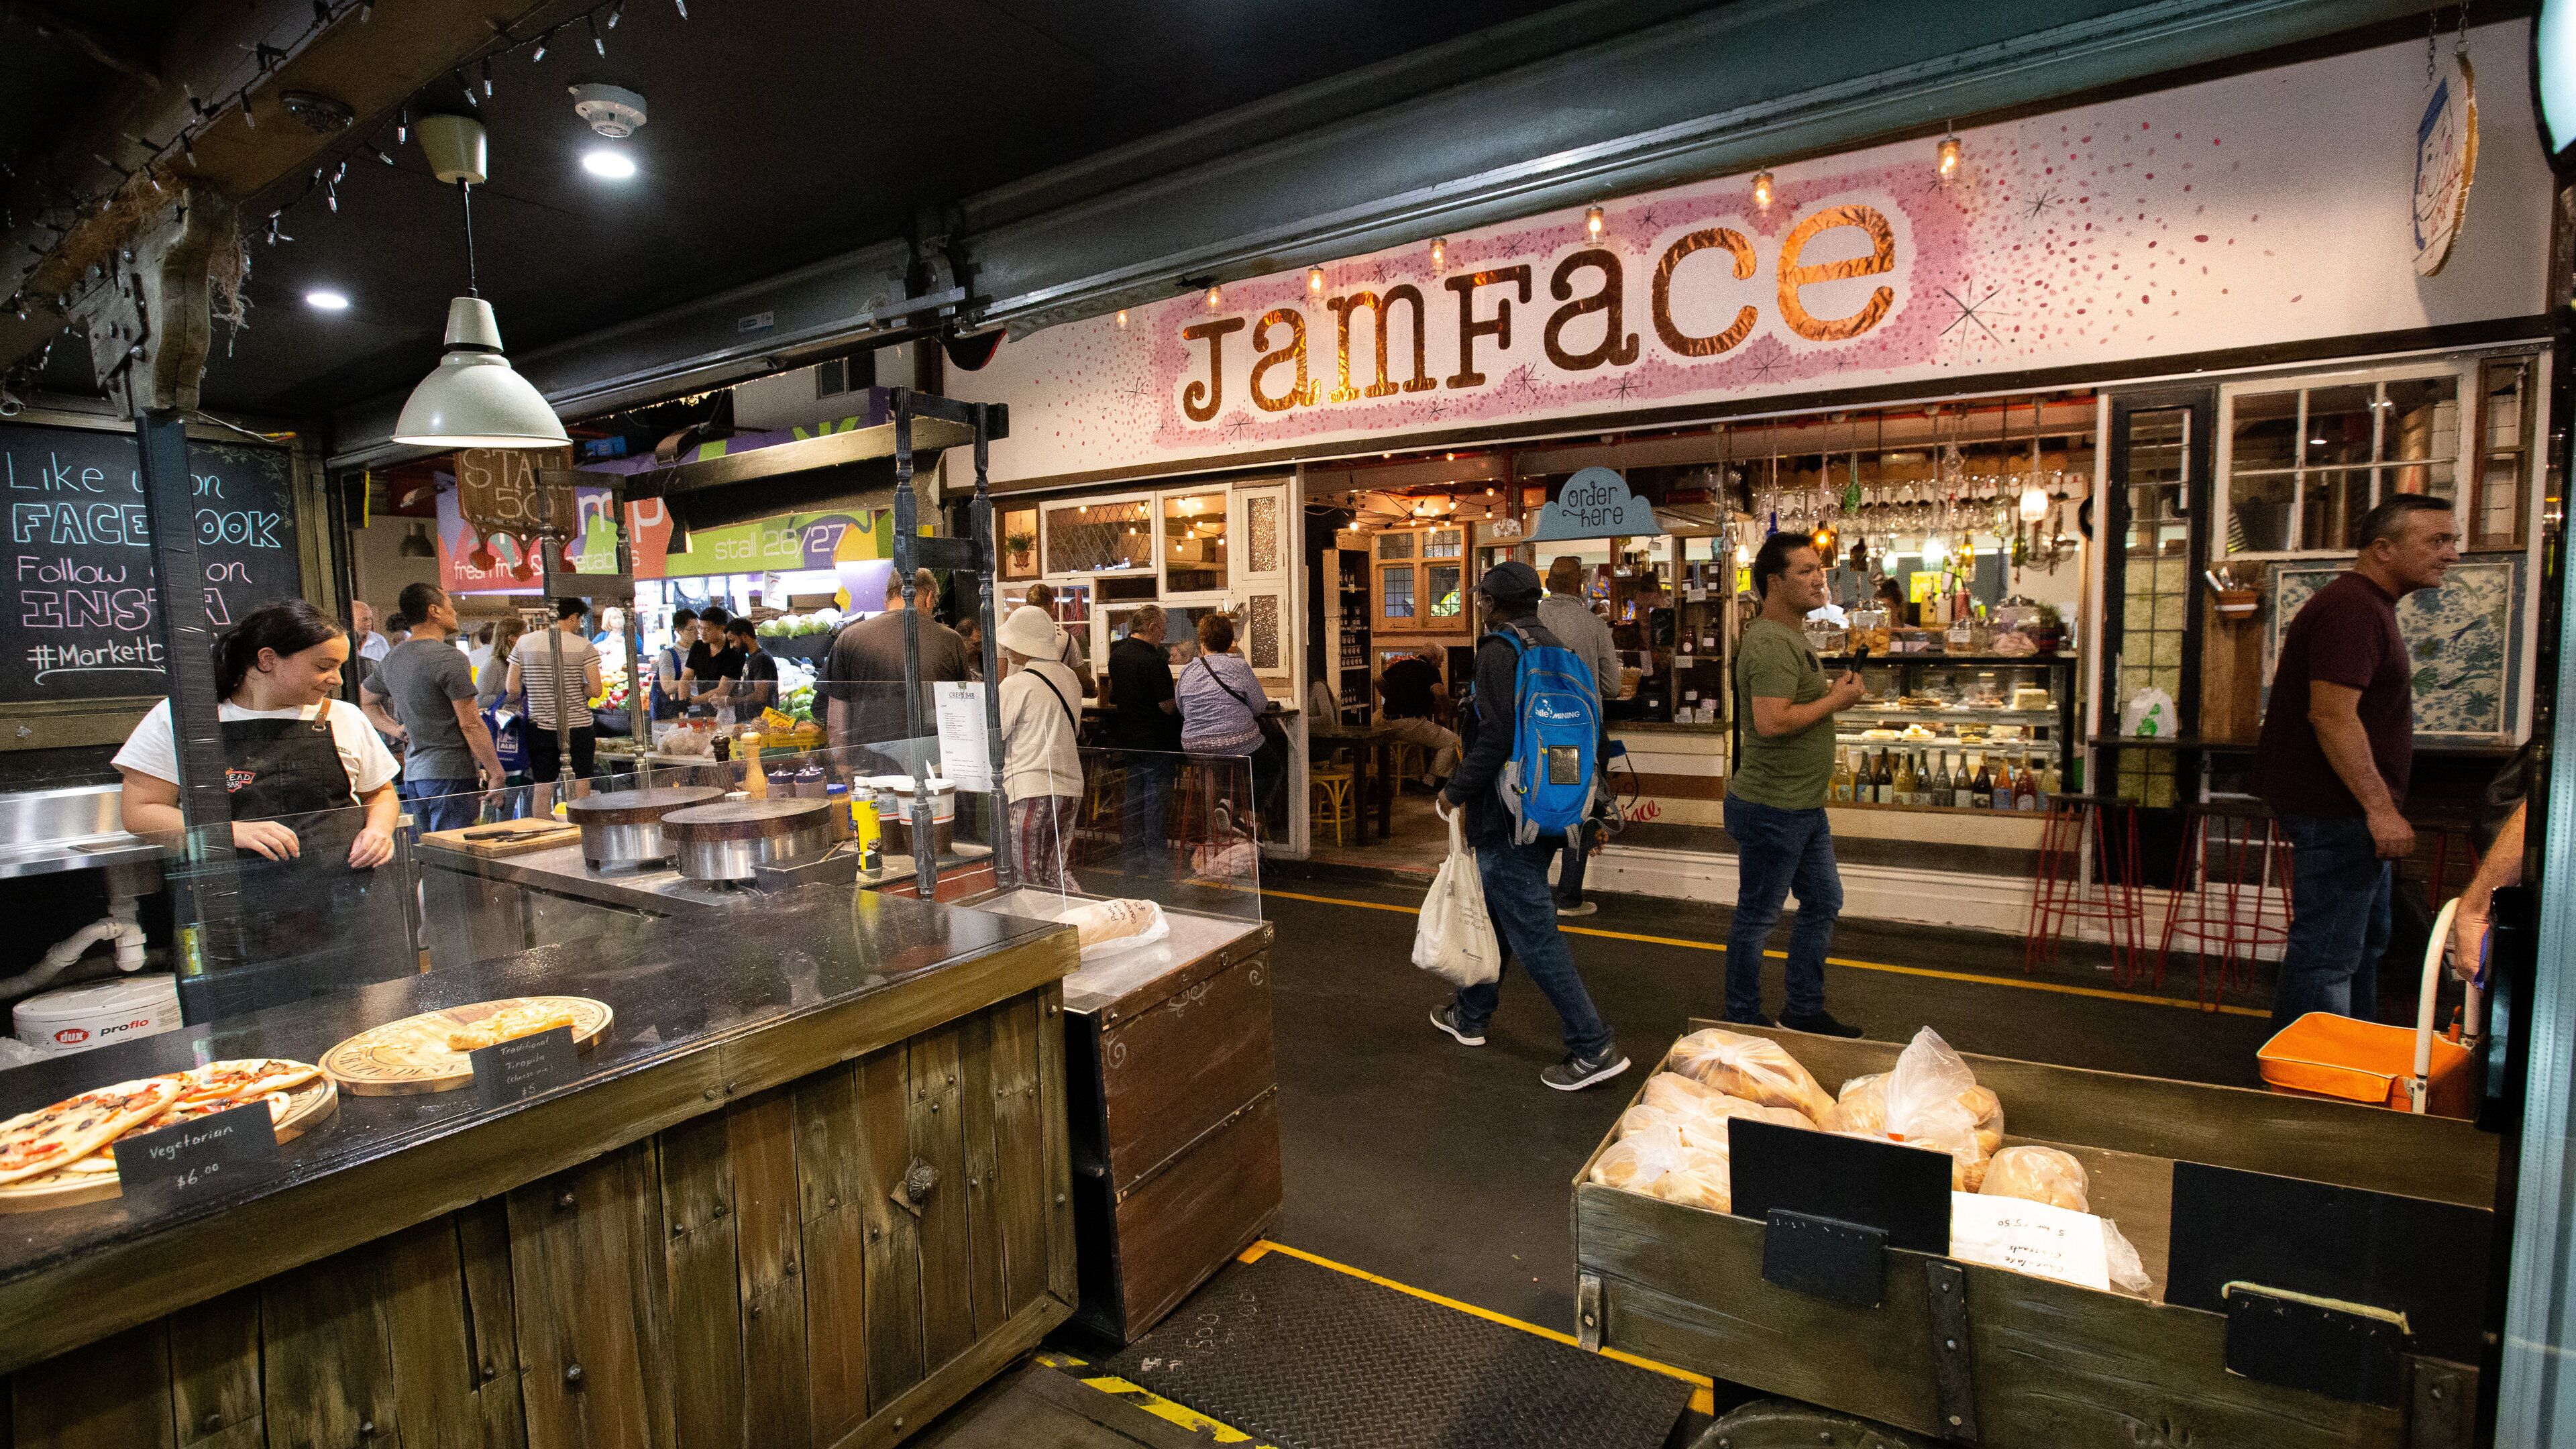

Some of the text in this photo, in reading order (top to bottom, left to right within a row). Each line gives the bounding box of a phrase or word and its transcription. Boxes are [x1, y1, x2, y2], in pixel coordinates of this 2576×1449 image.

[7, 451, 105, 493] Like
[1568, 481, 1618, 508] order
[13, 503, 281, 548] FACEOOK
[1562, 506, 1623, 528] here
[715, 523, 847, 561] stall 26/27
[18, 555, 126, 584] Follow
[207, 561, 252, 584] on
[21, 588, 231, 631] INSA
[1552, 710, 1580, 719] MINING
[60, 1019, 150, 1042] dux proflo
[149, 1126, 234, 1161] Vegetarian
